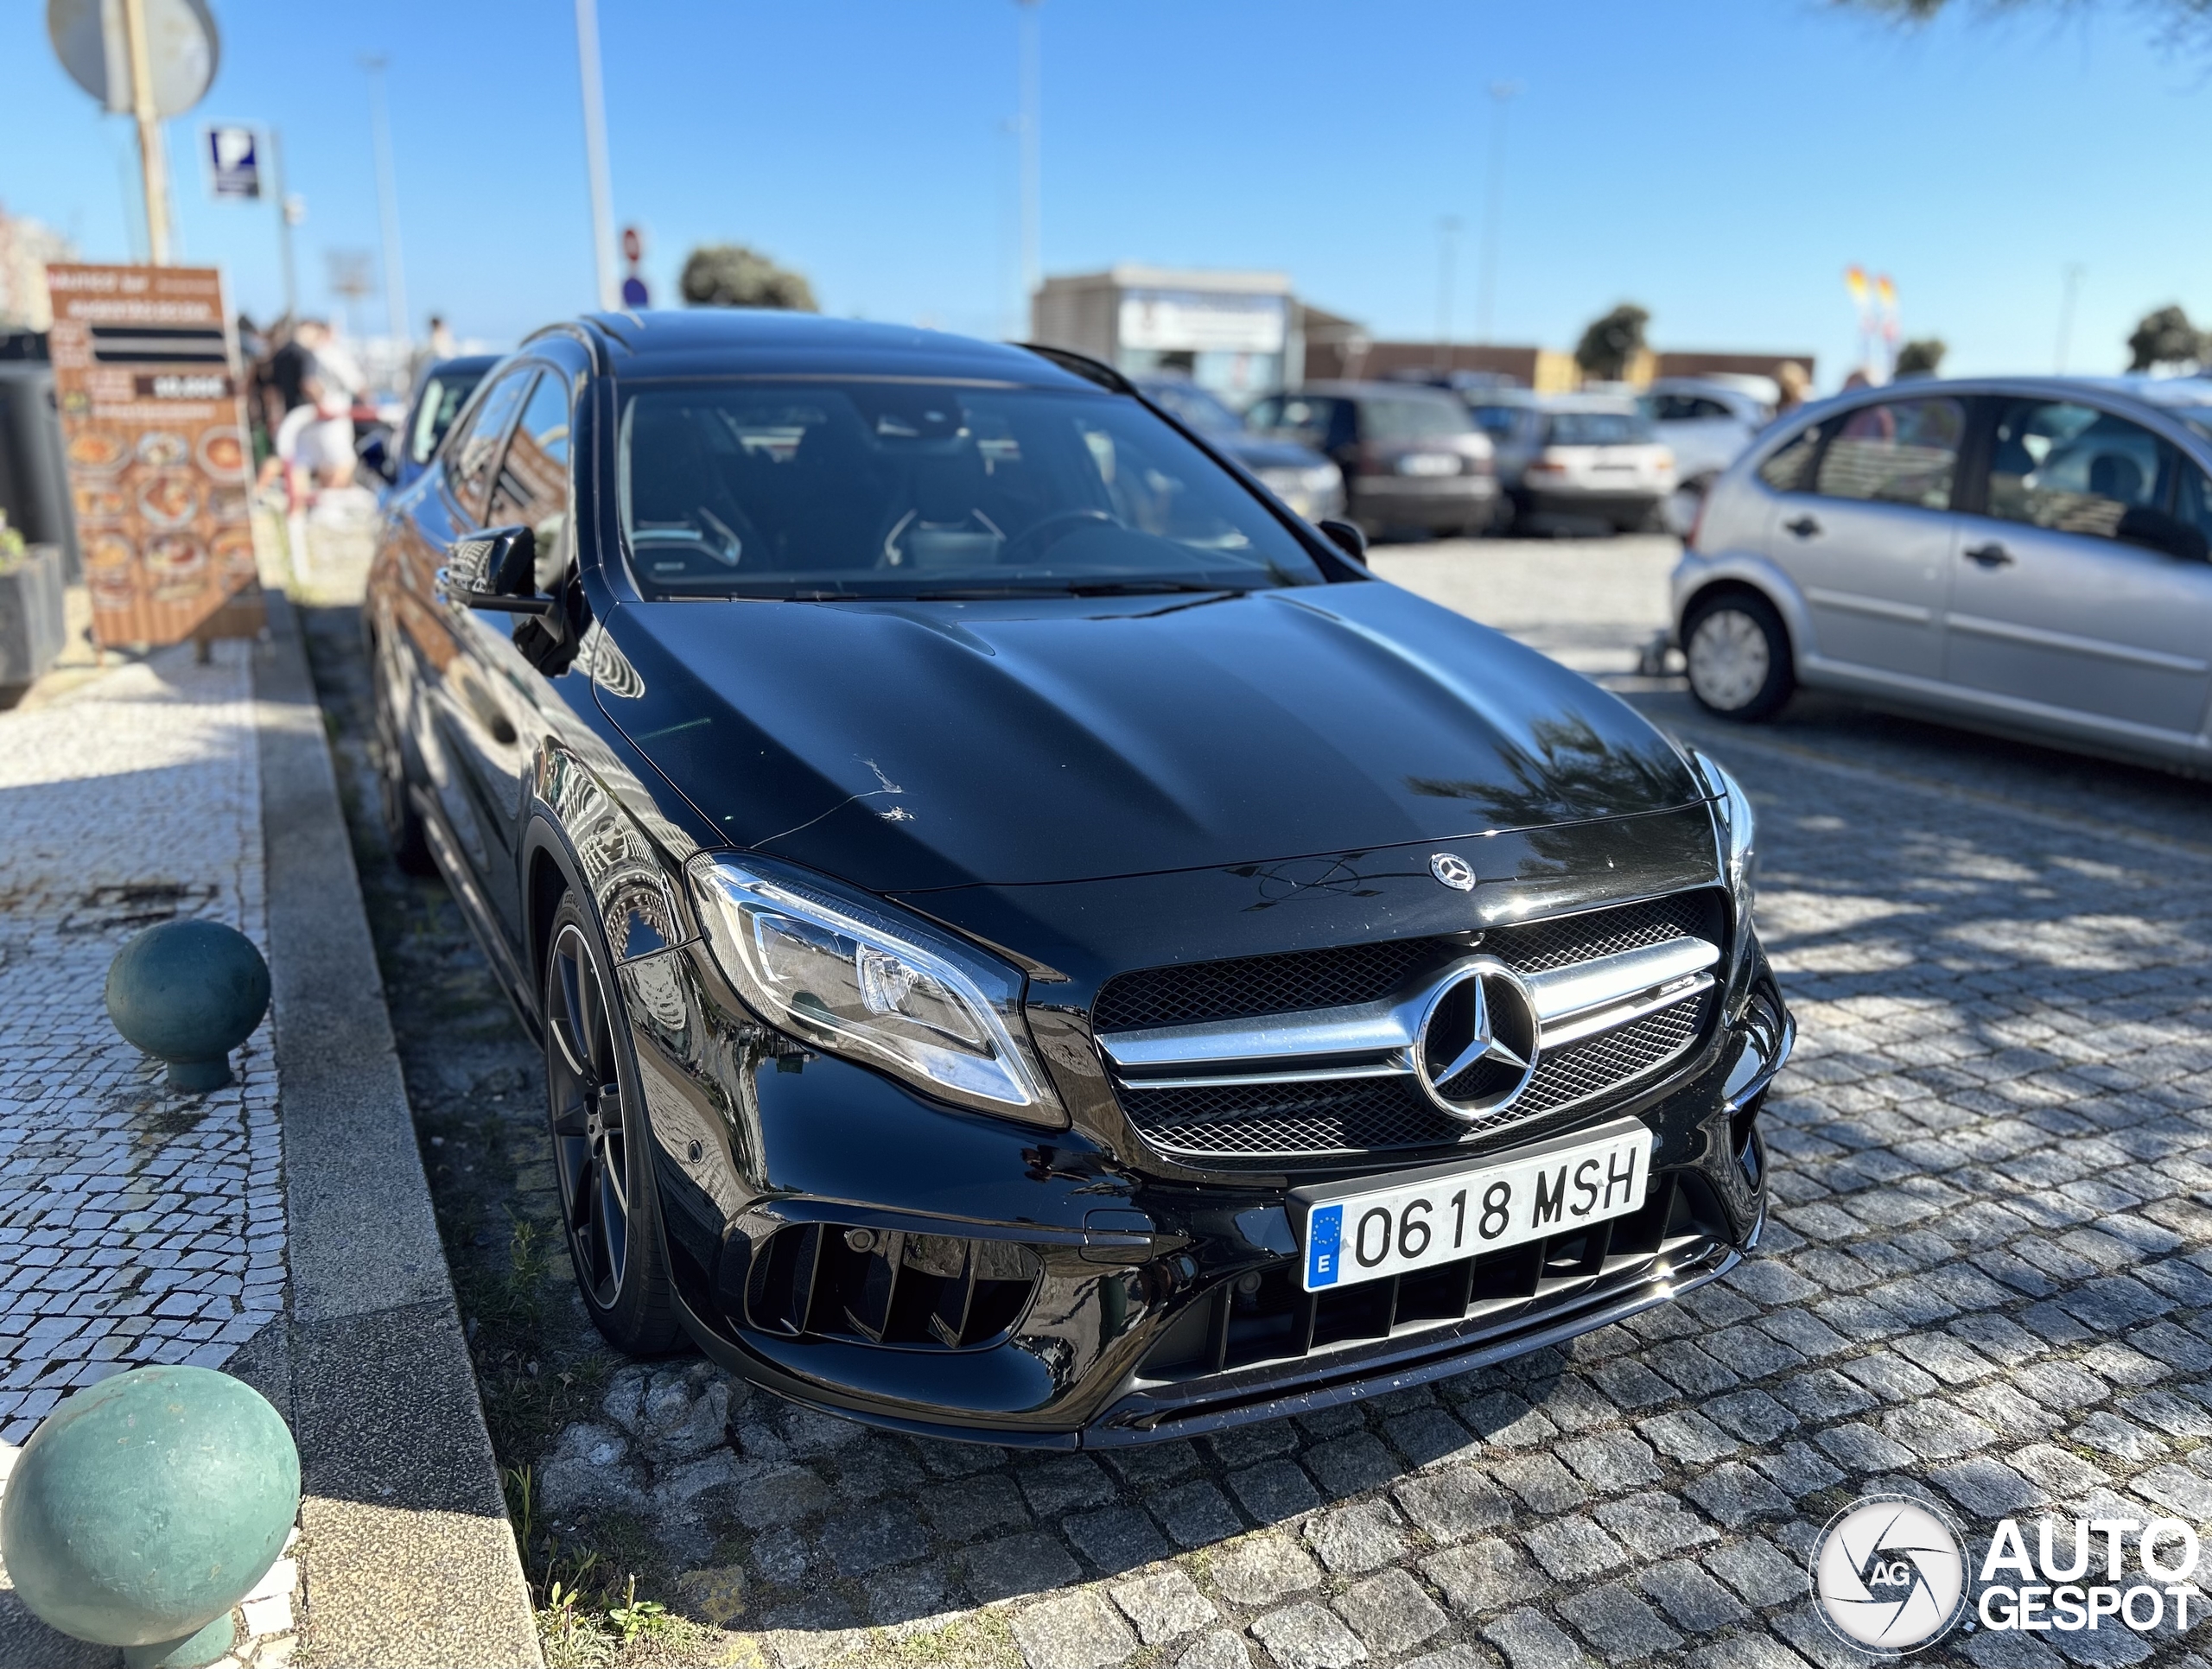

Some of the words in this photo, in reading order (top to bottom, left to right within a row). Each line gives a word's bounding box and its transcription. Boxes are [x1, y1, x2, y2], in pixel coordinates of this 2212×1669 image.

[1355, 1180, 1512, 1268] 0618
[1532, 1147, 1637, 1229] MSH
[1318, 1254, 1331, 1273] E
